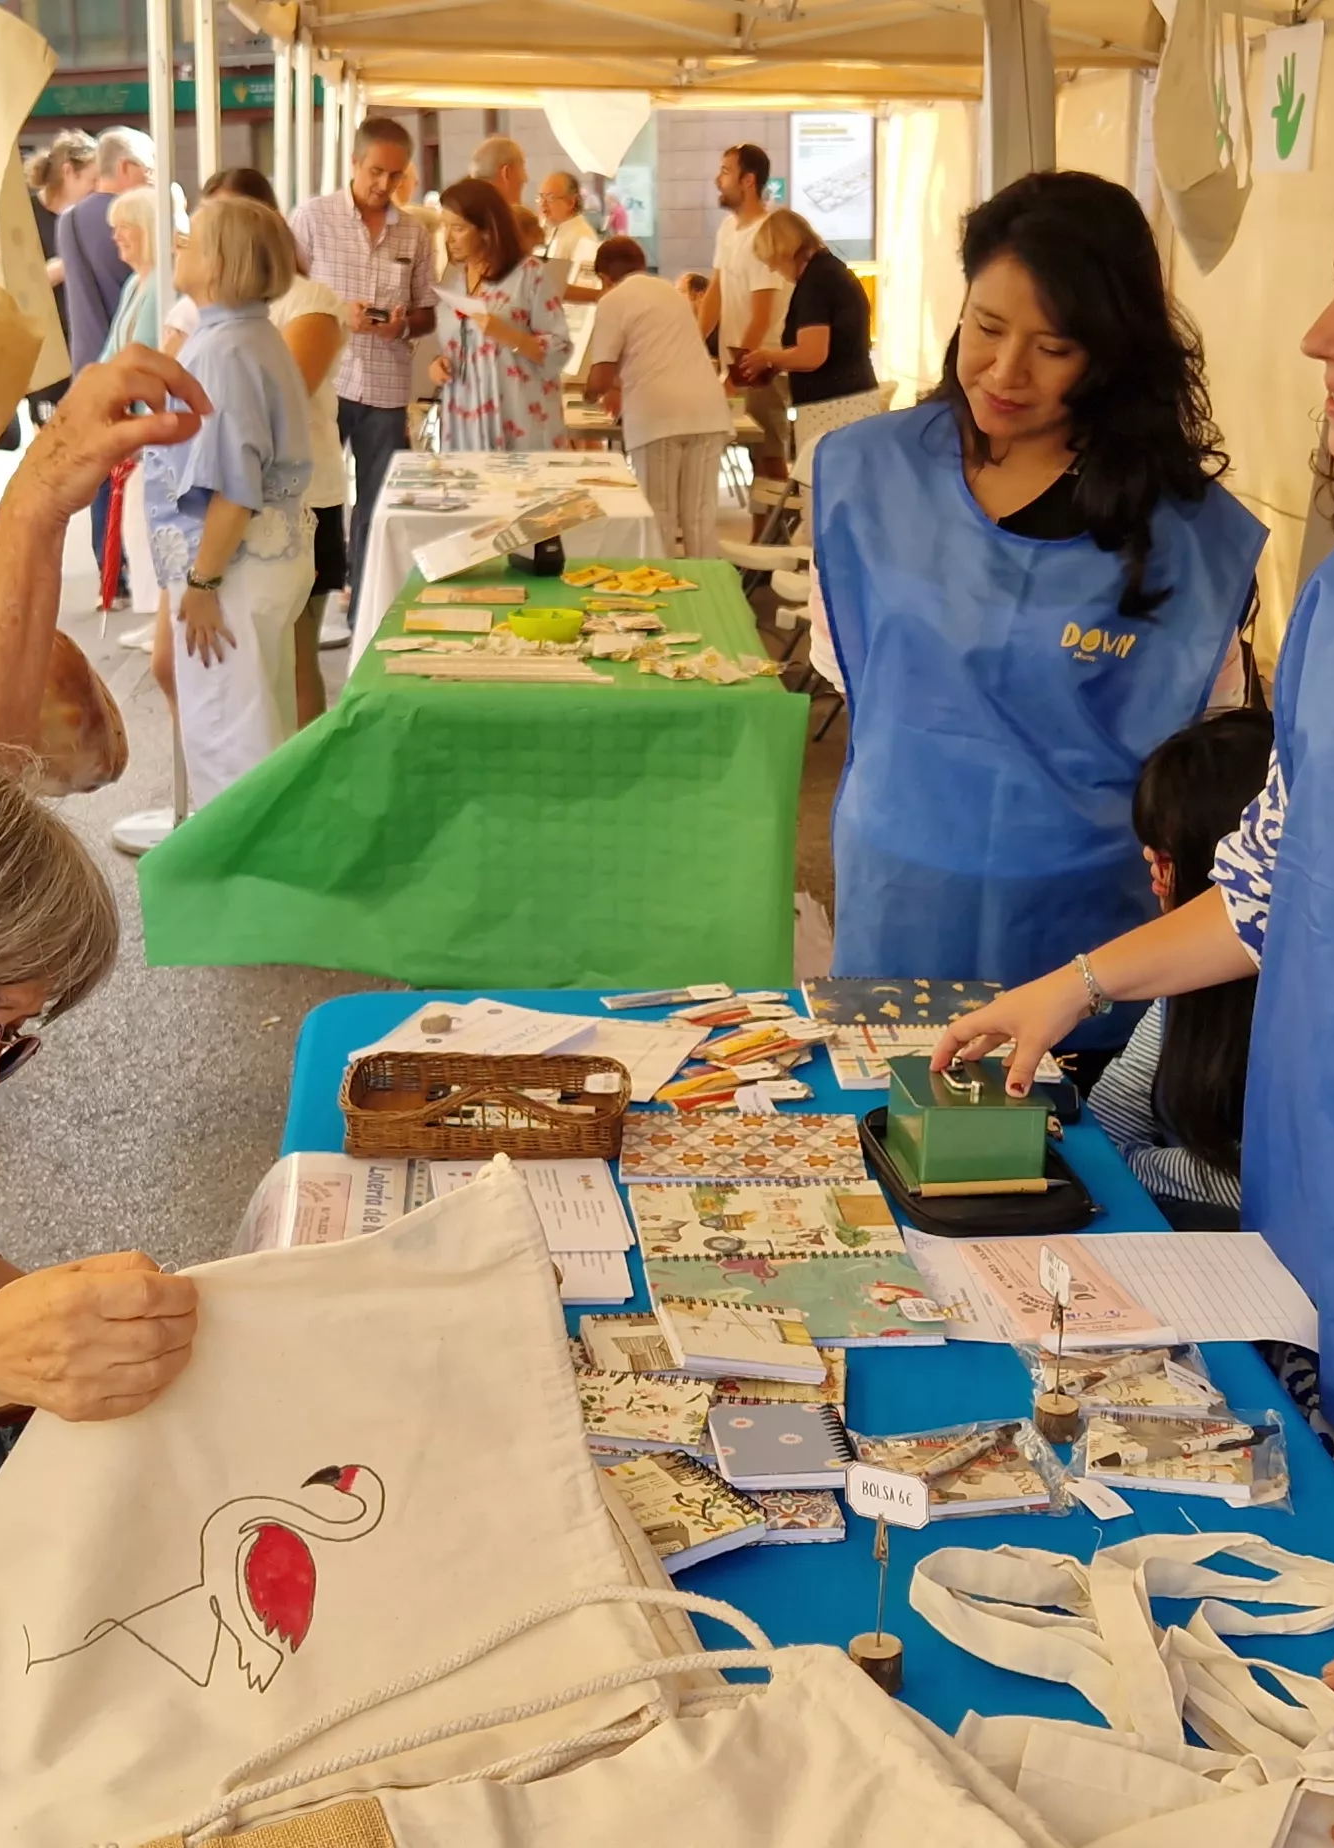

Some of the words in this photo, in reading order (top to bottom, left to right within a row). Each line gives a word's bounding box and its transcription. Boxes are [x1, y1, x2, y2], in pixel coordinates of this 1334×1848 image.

[1060, 620, 1137, 659] DOWN
[362, 1207, 388, 1223] de
[862, 1480, 896, 1503] BOLSA
[898, 1489, 914, 1507] 6€
